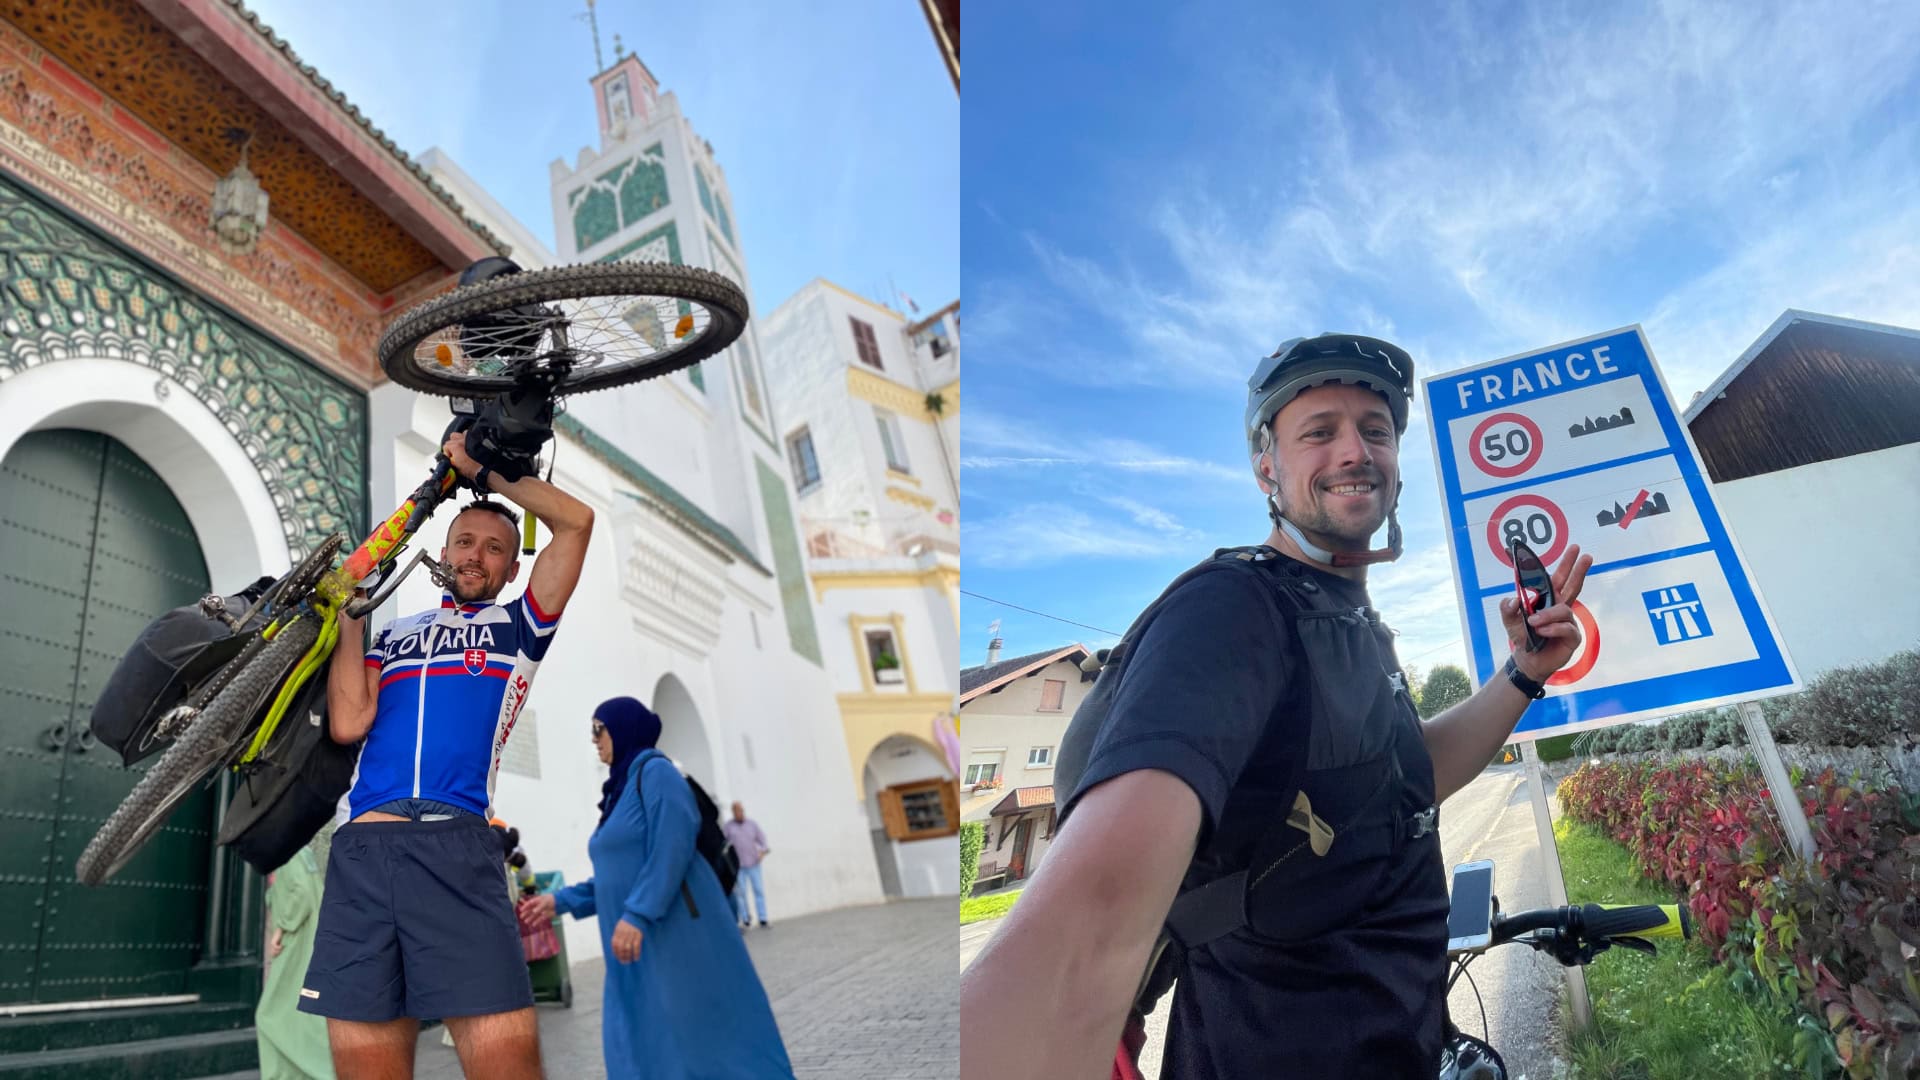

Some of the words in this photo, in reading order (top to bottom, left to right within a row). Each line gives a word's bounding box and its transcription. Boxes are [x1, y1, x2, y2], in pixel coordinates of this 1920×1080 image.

[1456, 345, 1619, 409] FRANCE
[1484, 429, 1530, 461] 50
[1504, 513, 1552, 549] 80
